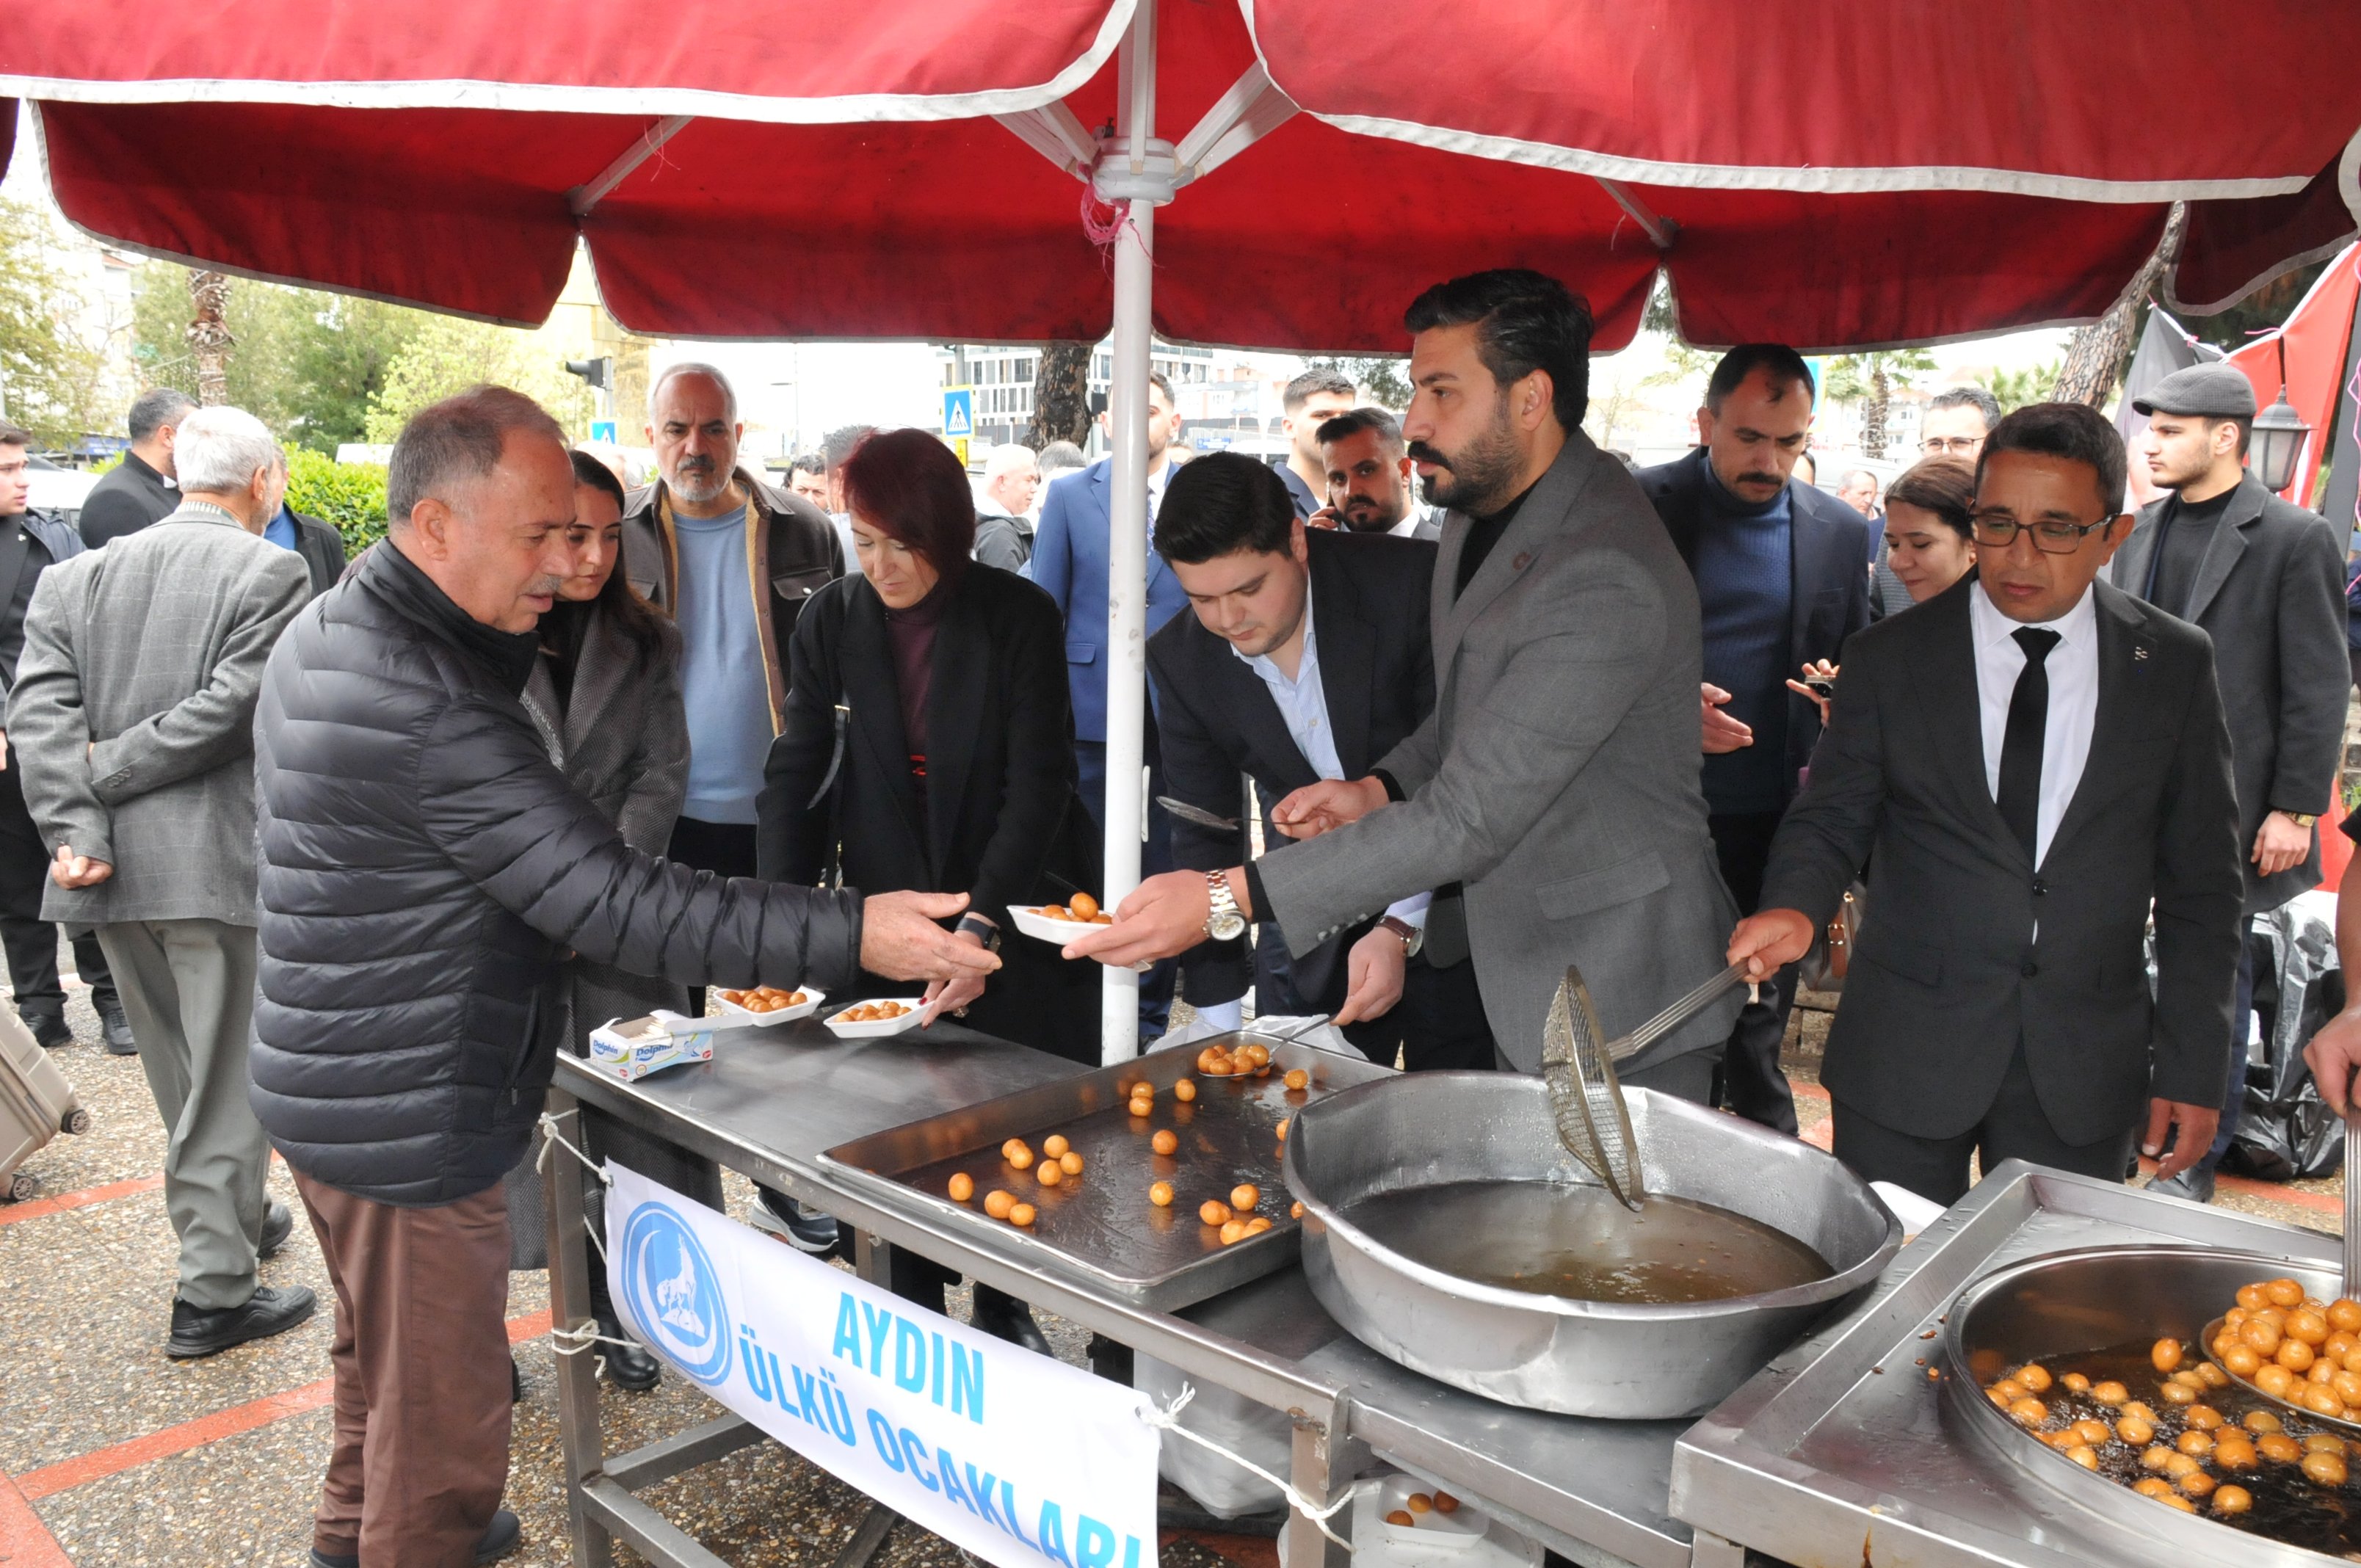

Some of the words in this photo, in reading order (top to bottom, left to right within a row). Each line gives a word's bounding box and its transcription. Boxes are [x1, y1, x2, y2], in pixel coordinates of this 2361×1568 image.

[593, 1039, 618, 1055] Dolphin
[739, 1324, 857, 1447] ÜLKÜ
[833, 1292, 984, 1425] AYDIN
